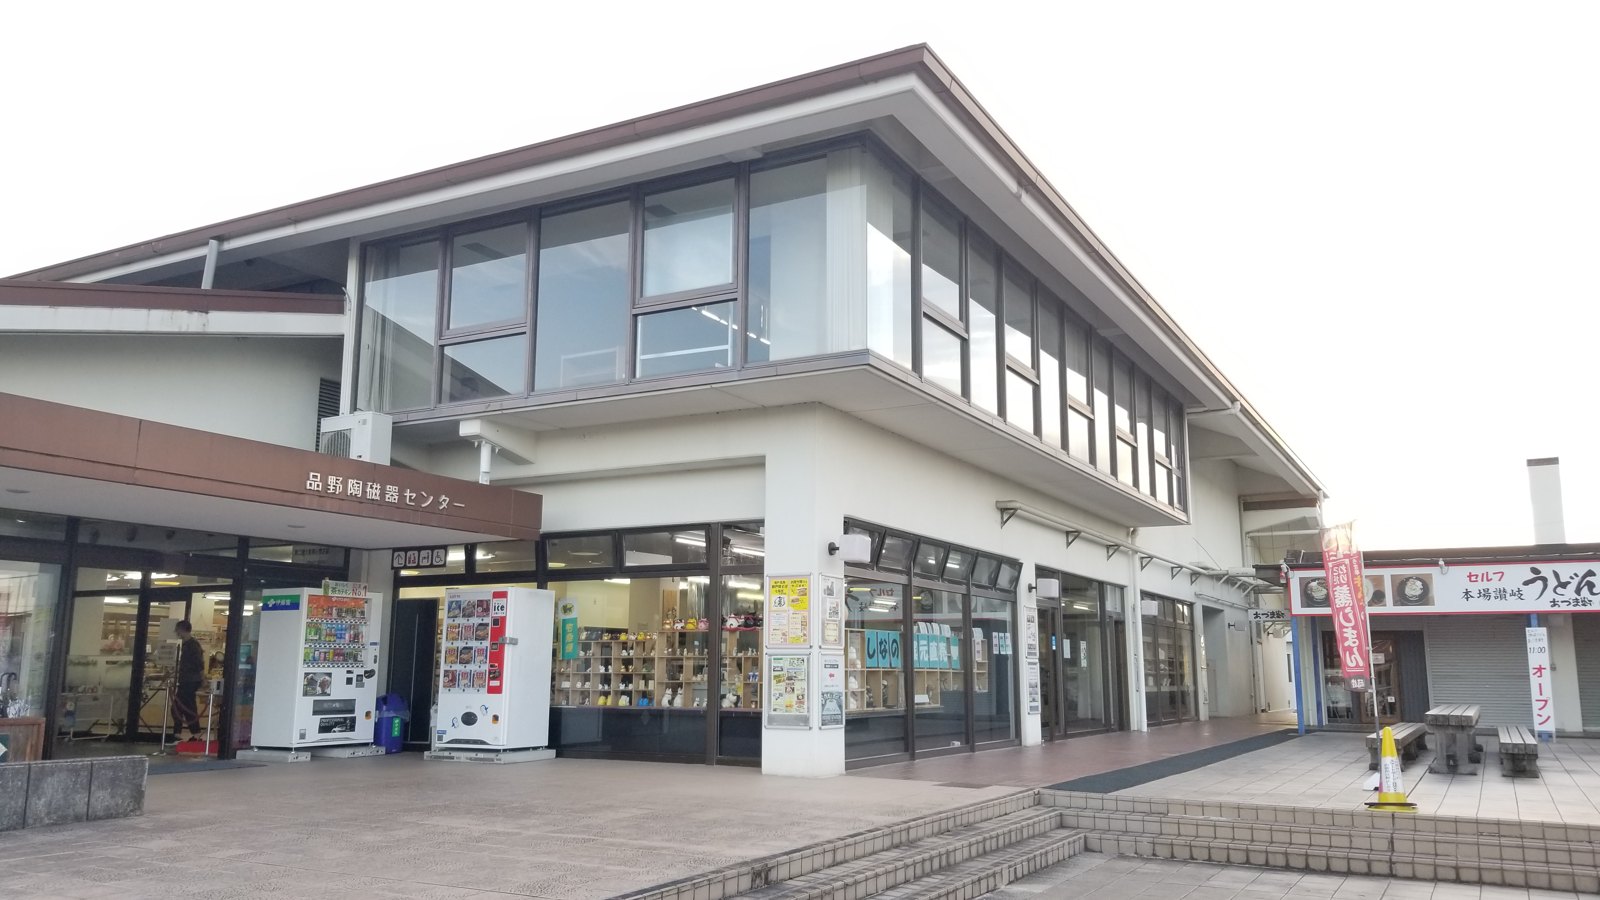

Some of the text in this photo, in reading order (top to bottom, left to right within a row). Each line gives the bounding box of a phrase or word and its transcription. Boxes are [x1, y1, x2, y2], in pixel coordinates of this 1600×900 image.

[306, 472, 465, 510] 品野陶磁器センター
[1467, 571, 1505, 583] セルフ
[1522, 566, 1600, 600] うどん
[867, 637, 900, 660] しなの
[1531, 664, 1551, 726] オープン
